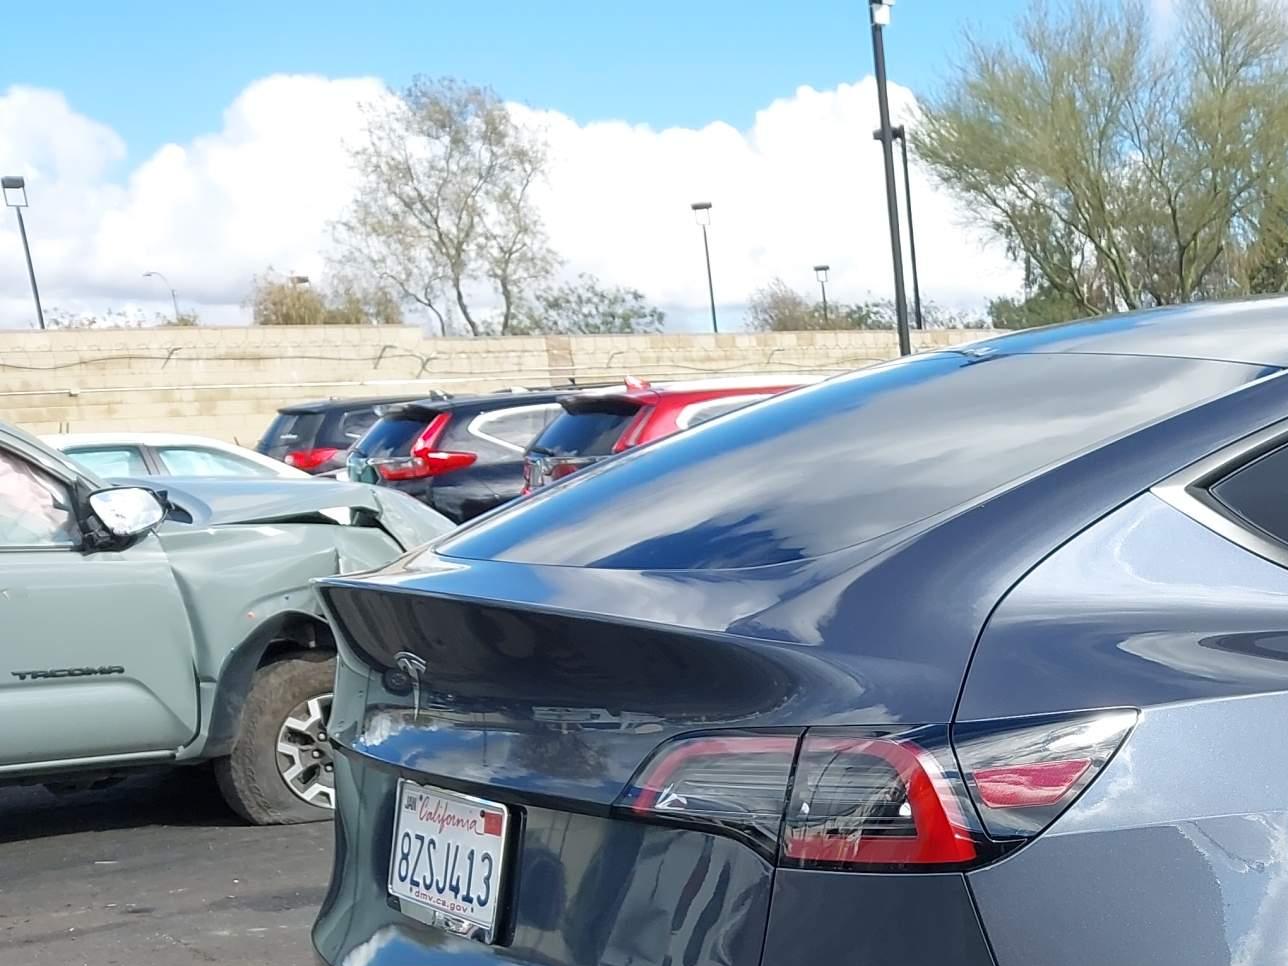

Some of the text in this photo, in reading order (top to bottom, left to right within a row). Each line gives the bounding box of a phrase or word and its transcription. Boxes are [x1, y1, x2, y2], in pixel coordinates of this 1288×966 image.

[11, 666, 125, 680] TACOMA
[418, 796, 485, 835] California
[398, 831, 494, 907] 8ZSJ413
[415, 890, 468, 913] dmv.ca.gov
